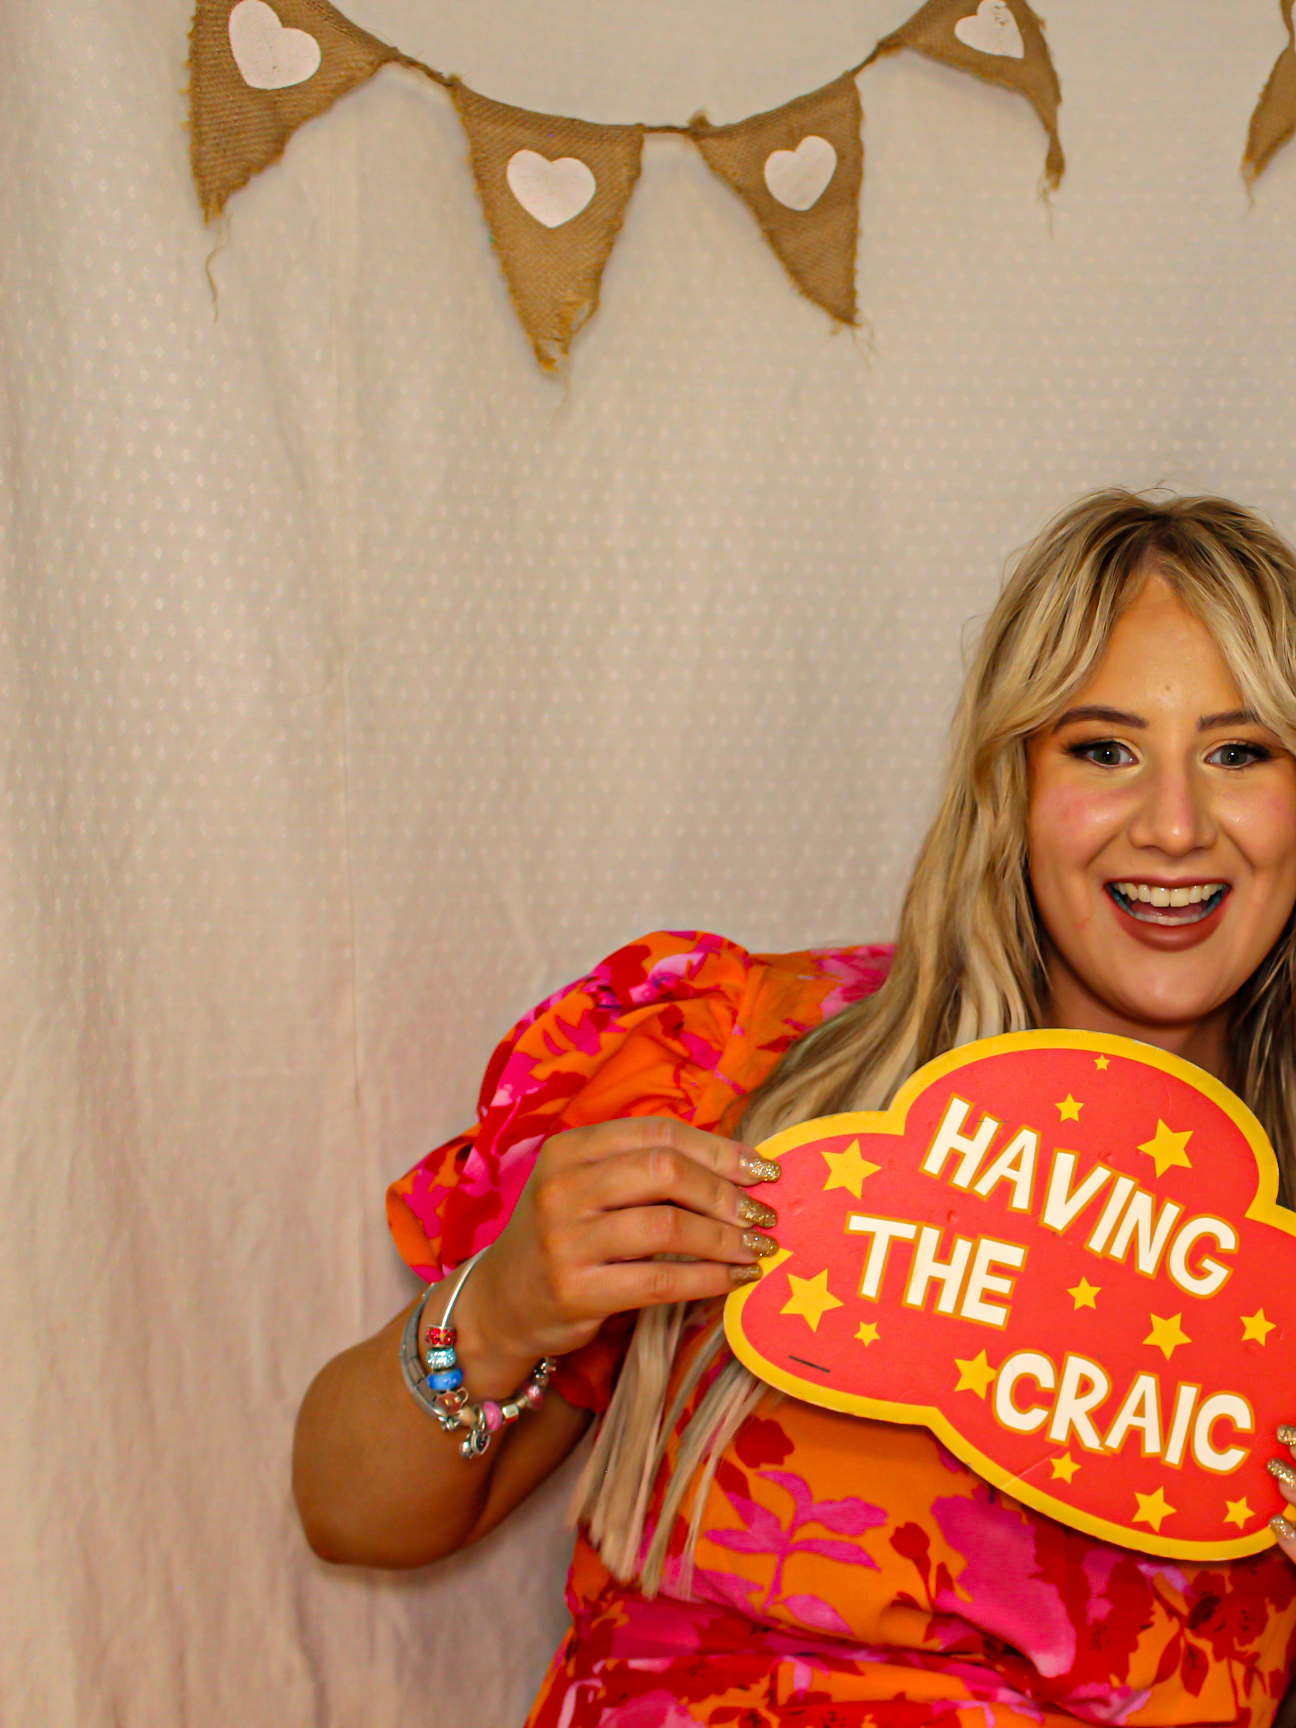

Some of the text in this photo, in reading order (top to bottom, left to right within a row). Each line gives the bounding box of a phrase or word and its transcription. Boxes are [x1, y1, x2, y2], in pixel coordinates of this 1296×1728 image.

[921, 1095, 1240, 1298] HAVING
[846, 1213, 1027, 1328] THE
[994, 1351, 1253, 1472] CRAIC
